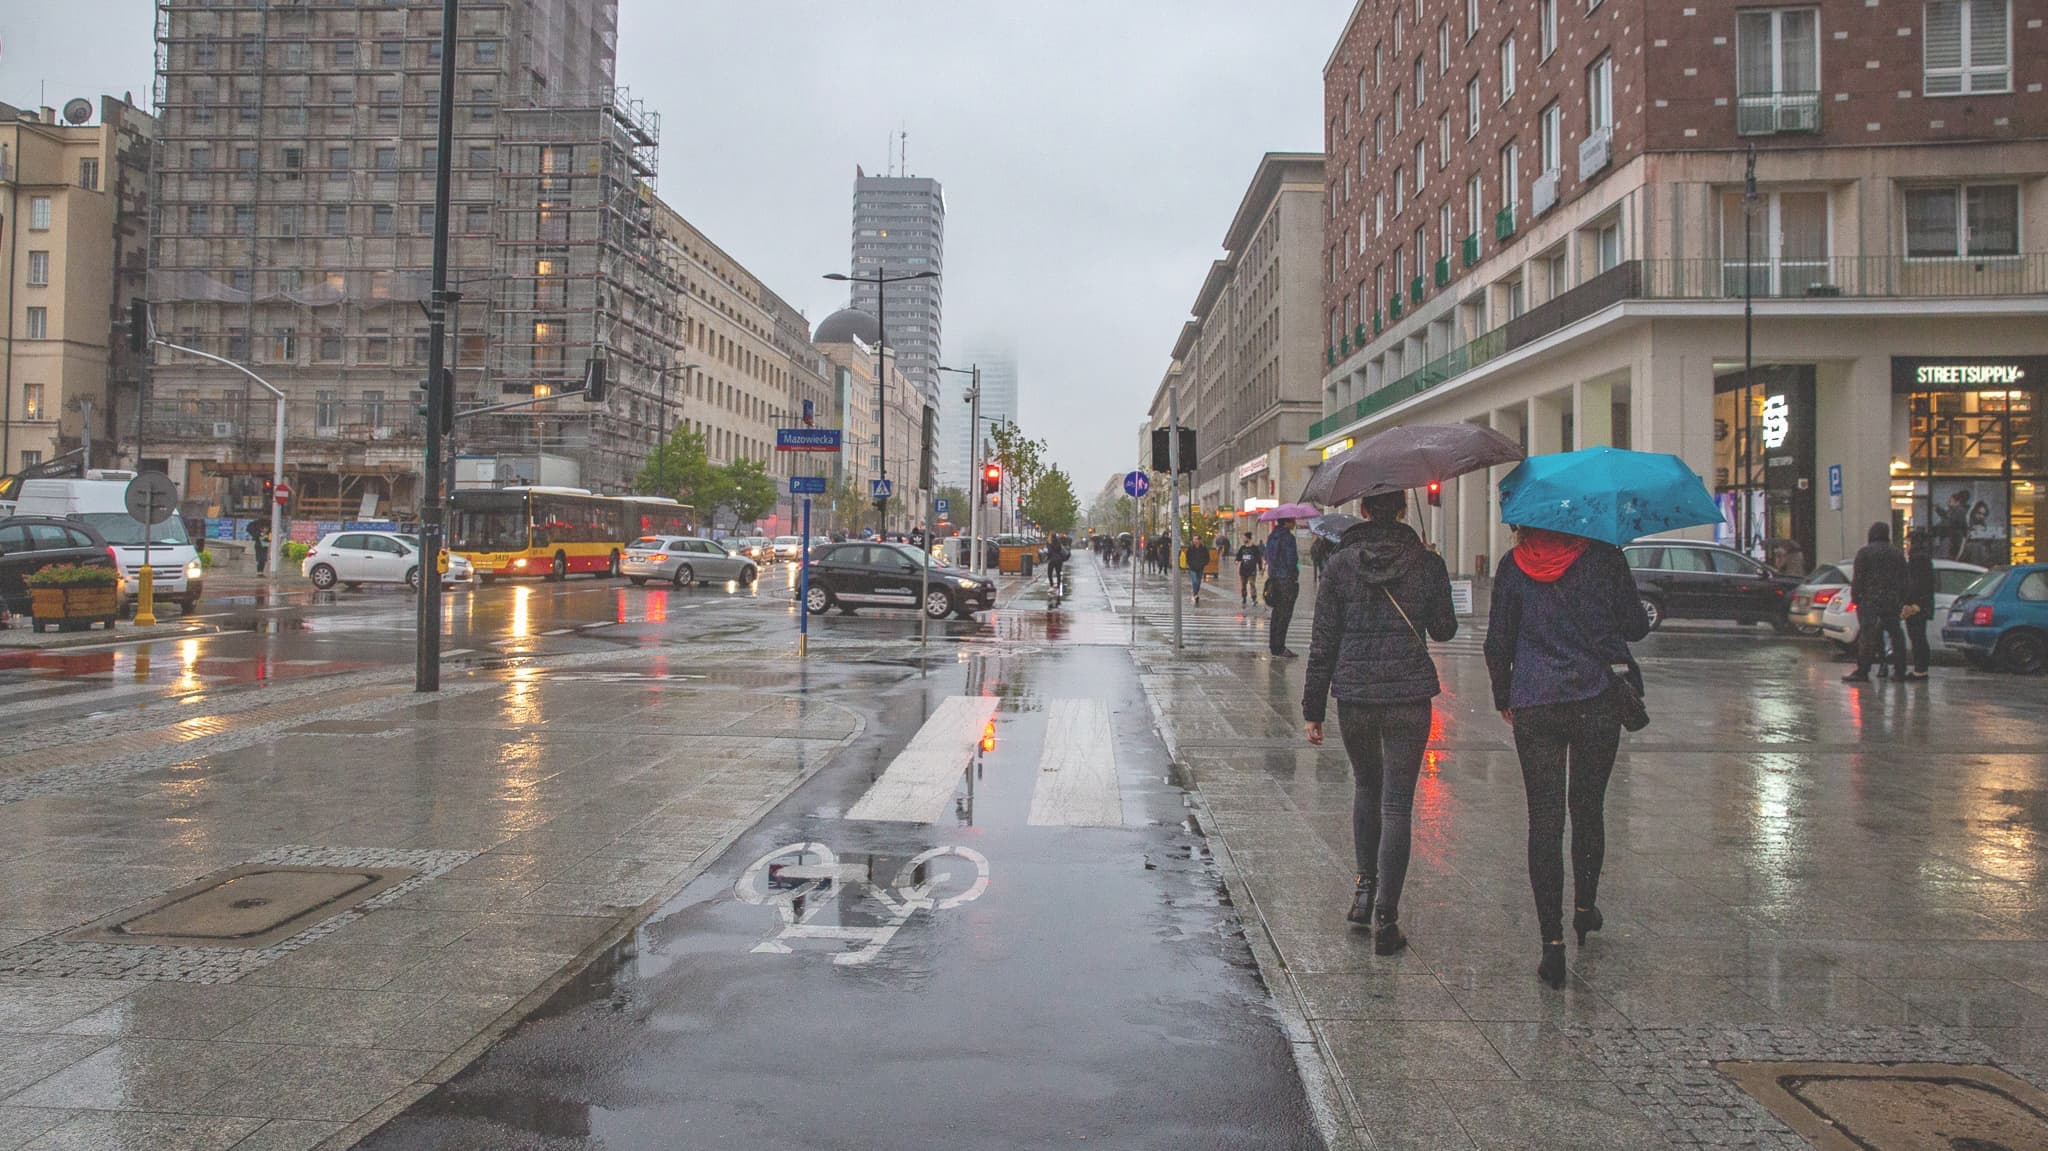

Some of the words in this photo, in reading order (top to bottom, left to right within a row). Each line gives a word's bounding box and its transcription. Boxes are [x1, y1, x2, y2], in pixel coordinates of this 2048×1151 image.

[1917, 365, 2019, 383] STREETSUPPLY
[783, 434, 834, 445] Mazowiecka
[793, 480, 801, 489] P
[1831, 468, 1840, 492] P
[937, 500, 946, 511] P
